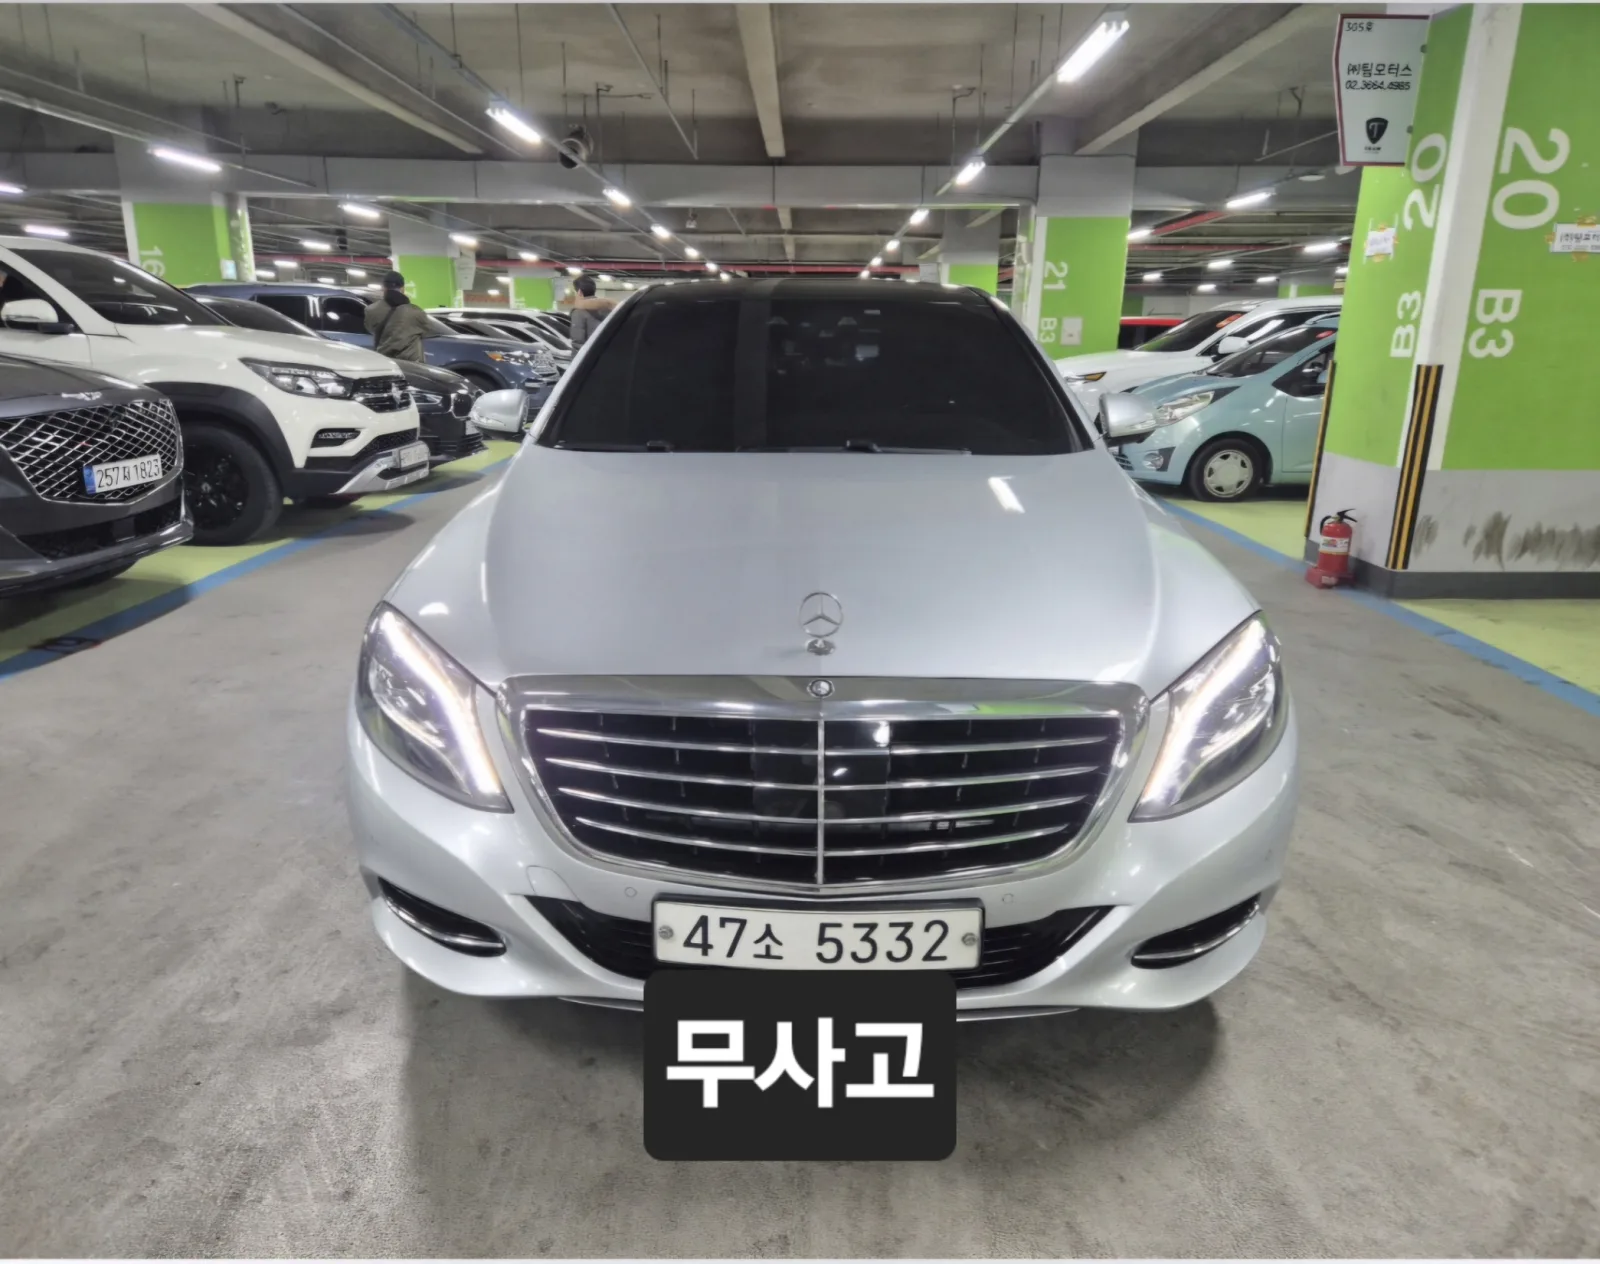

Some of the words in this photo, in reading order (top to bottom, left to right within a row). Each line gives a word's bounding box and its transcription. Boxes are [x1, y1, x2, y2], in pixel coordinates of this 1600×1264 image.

[1403, 133, 1448, 231] 20
[1492, 127, 1570, 230] 20
[1043, 261, 1069, 290] 21
[1040, 317, 1058, 343] B3
[1390, 290, 1422, 358] B3
[1468, 288, 1523, 359] B3
[133, 458, 160, 481] 1823
[682, 915, 784, 960] 47소
[815, 919, 949, 964] 5332
